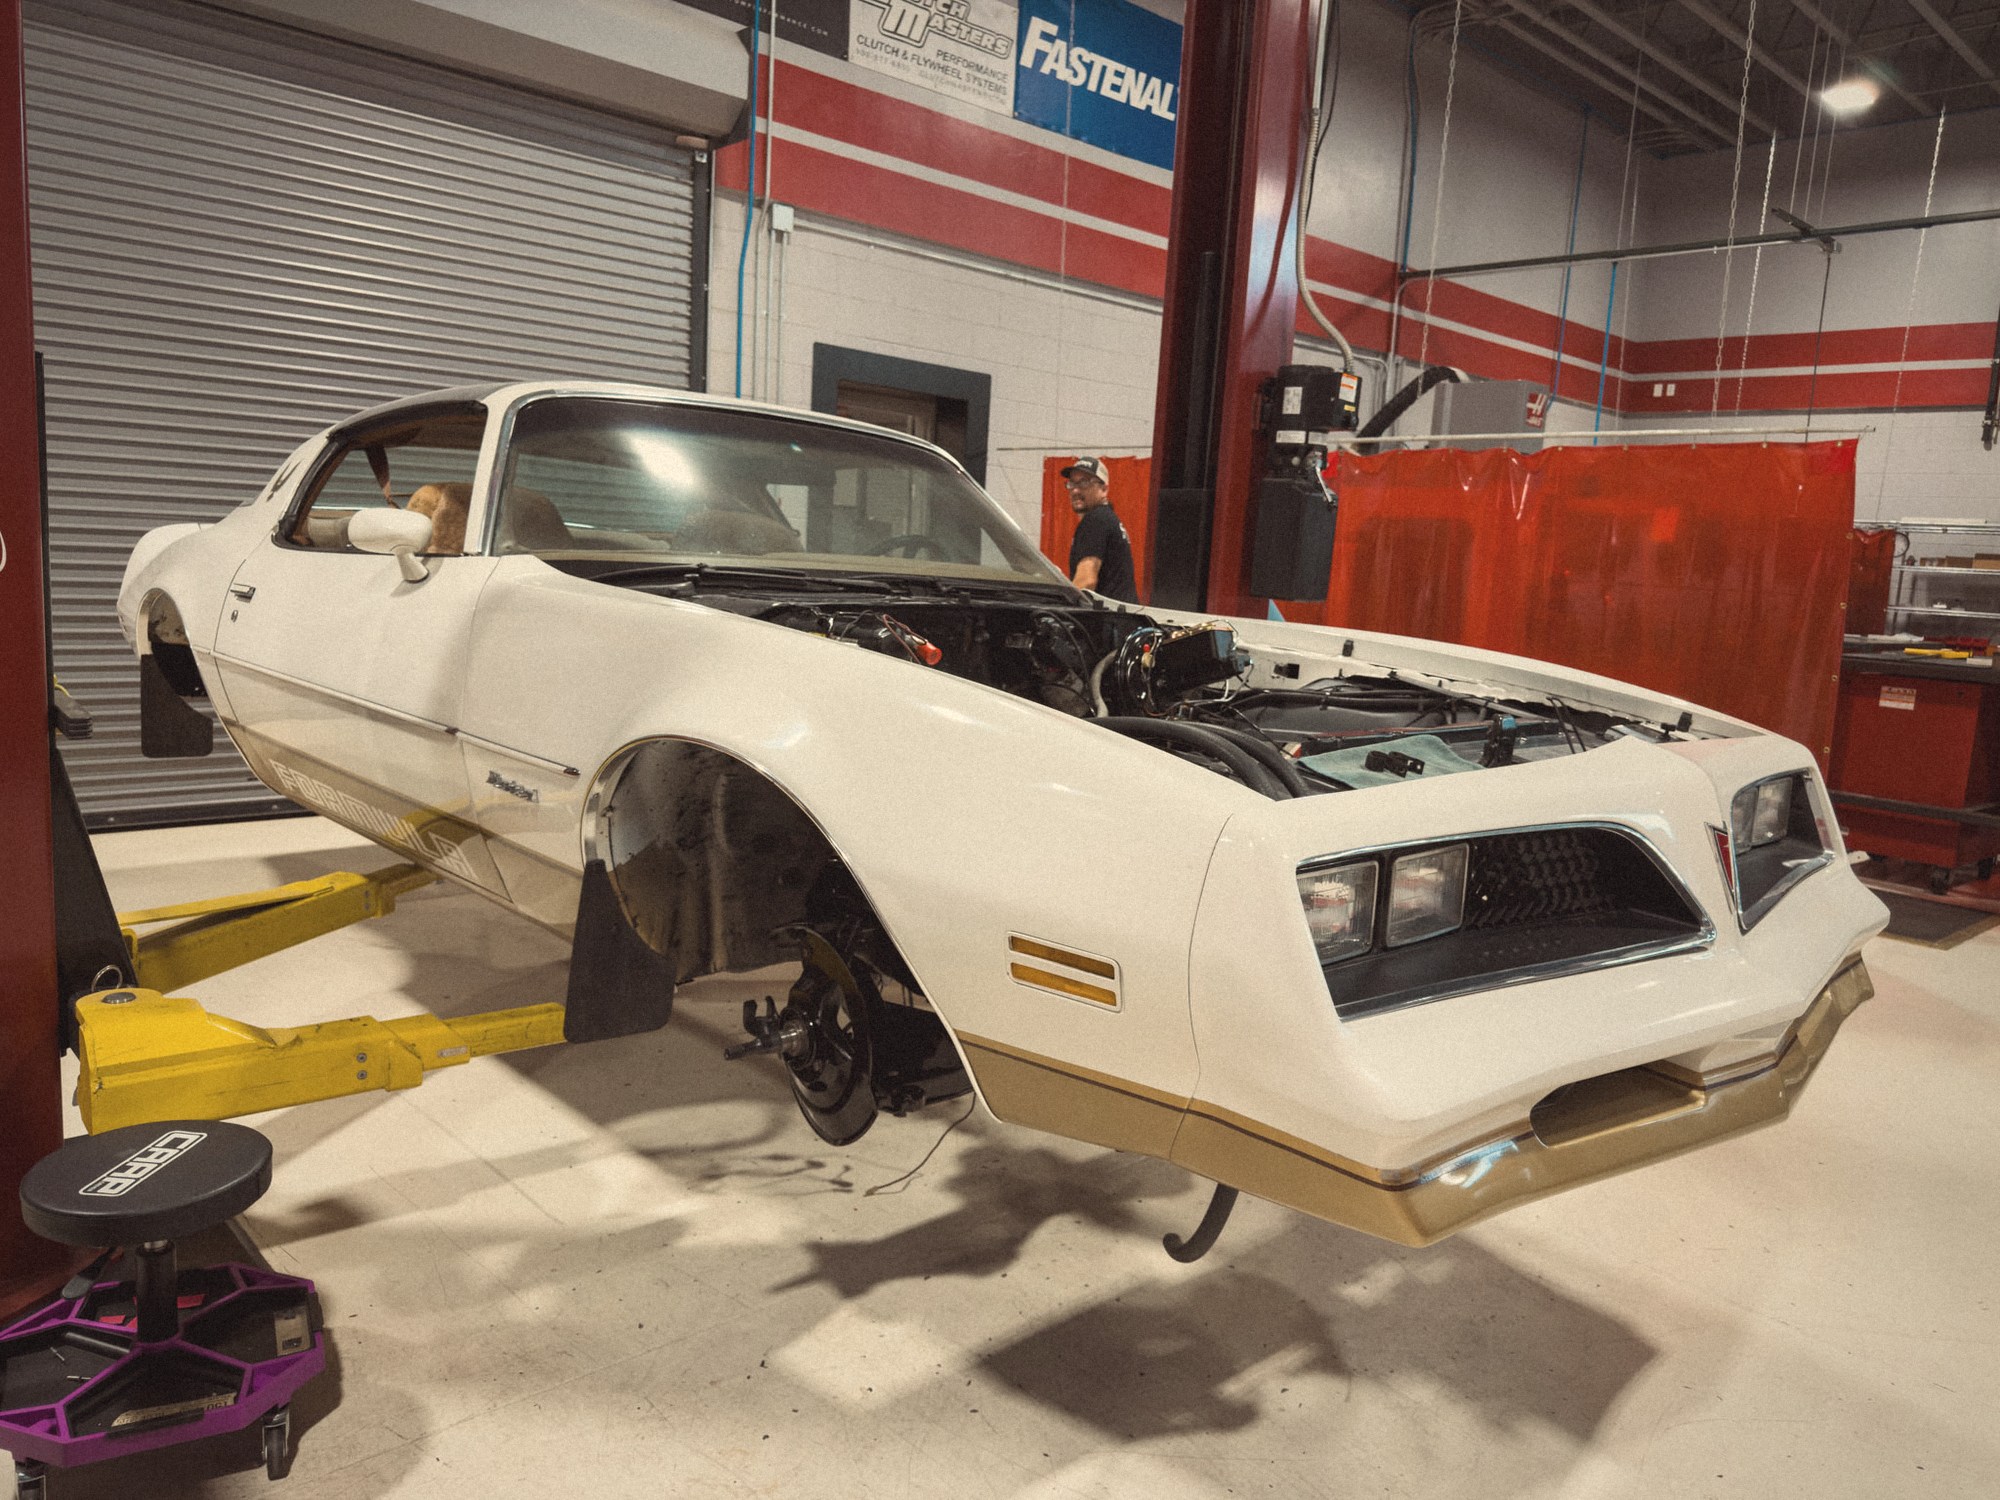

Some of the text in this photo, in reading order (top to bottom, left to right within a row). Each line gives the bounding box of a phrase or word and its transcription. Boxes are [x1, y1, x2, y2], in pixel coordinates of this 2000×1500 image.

[882, 0, 1011, 53] MASTERS
[856, 34, 900, 58] CLUTCH
[901, 50, 909, 61] &
[909, 53, 963, 80] FLYWHEEL
[965, 72, 1009, 96] SYSTEMS
[936, 49, 1009, 84] PERFORMANCE
[1019, 16, 1176, 121] FASTENAL
[268, 758, 480, 882] FORMULA
